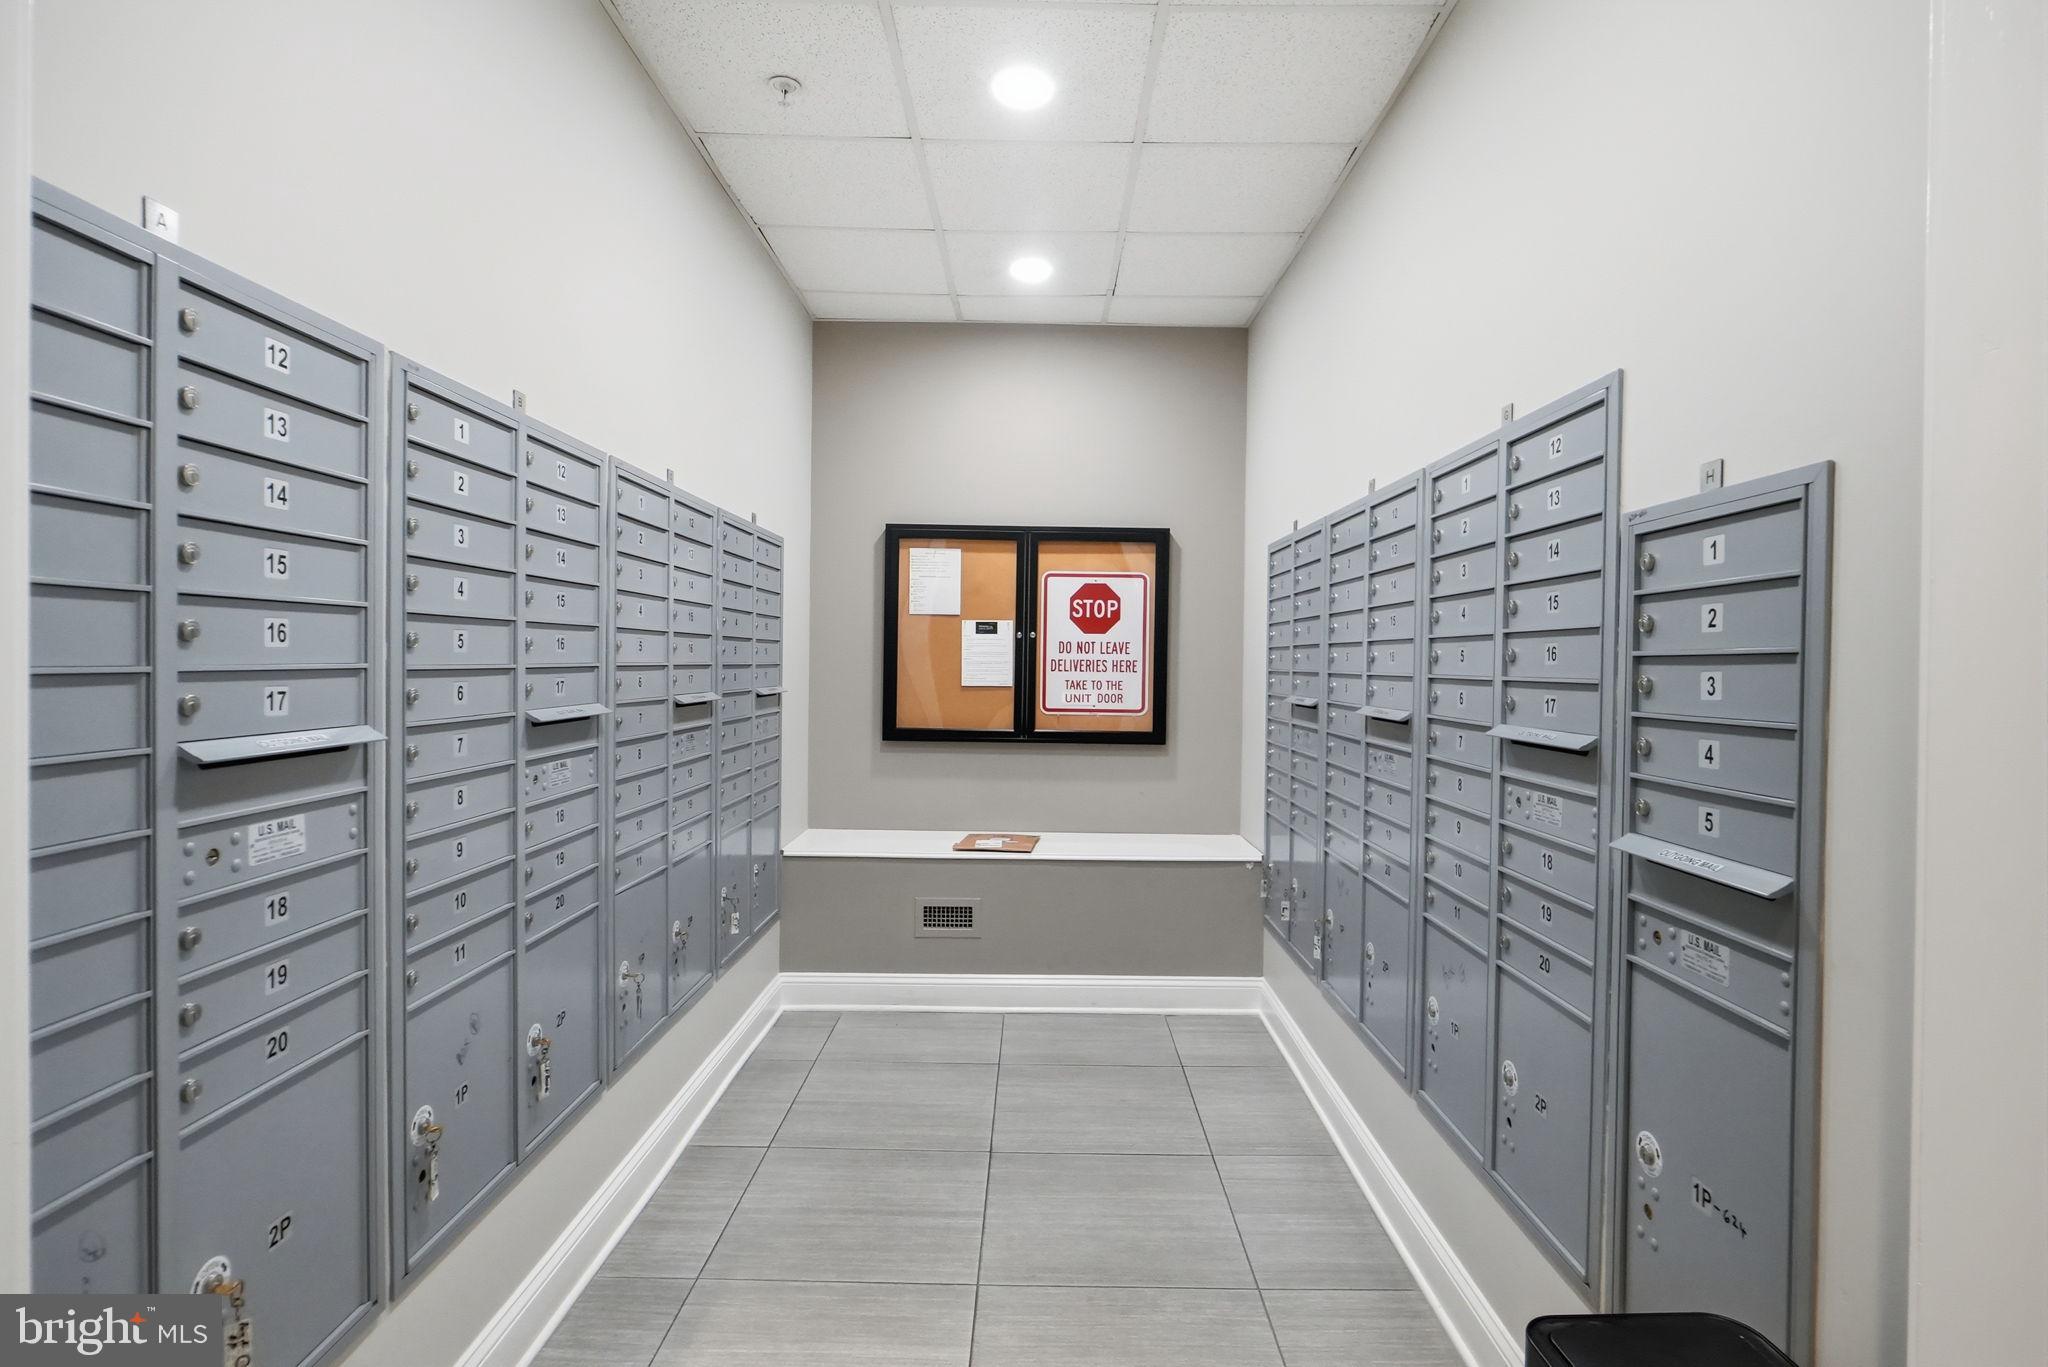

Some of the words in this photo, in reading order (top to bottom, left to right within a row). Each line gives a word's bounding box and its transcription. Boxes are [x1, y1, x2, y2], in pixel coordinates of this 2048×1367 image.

[157, 213, 168, 230] A
[268, 342, 288, 369] 12
[267, 413, 287, 437] 13
[459, 424, 465, 439] 1
[1551, 438, 1561, 455] 12
[557, 464, 566, 478] 12
[1706, 470, 1714, 484] H
[458, 477, 465, 491] 2
[1463, 478, 1469, 490] 1
[267, 483, 287, 506] 14
[1549, 490, 1560, 506] 13
[557, 508, 566, 521] 13
[1462, 521, 1468, 534] 2
[458, 529, 465, 544] 3
[557, 551, 565, 564] 14
[1549, 542, 1559, 559] 14
[1709, 540, 1718, 560] 1
[267, 553, 287, 574] 15
[1461, 565, 1467, 577] 3
[457, 581, 464, 597] 4
[557, 594, 565, 607] 15
[1548, 595, 1559, 611] 15
[1072, 599, 1118, 619] STOP
[1461, 607, 1467, 619] 4
[1708, 608, 1717, 628] 2
[267, 622, 287, 643] 16
[457, 634, 465, 648] 5
[556, 637, 565, 650] 16
[1058, 641, 1072, 654] DO
[1076, 641, 1096, 654] NOT
[1100, 641, 1130, 654] LEAVE
[1459, 650, 1465, 662] 5
[1547, 646, 1557, 661] 16
[1050, 659, 1108, 672] DELIVERIES
[1112, 660, 1138, 673] HERE
[556, 681, 564, 693] 17
[1065, 680, 1087, 690] TAKE
[1091, 680, 1103, 690] TO
[1106, 680, 1123, 690] THE
[1707, 676, 1715, 696] 3
[456, 686, 464, 700] 6
[1065, 693, 1092, 703] UNIT
[1097, 693, 1123, 703] DOOR
[1458, 692, 1465, 705] 6
[266, 691, 287, 711] 17
[1545, 699, 1556, 713] 17
[457, 738, 464, 752] 7
[1458, 735, 1464, 748] 7
[1704, 744, 1714, 764] 4
[1457, 778, 1463, 791] 8
[456, 790, 464, 805] 8
[556, 810, 564, 823] 18
[1704, 812, 1713, 832] 5
[257, 824, 274, 836] U.S.
[277, 819, 297, 831] MAIL
[1455, 821, 1462, 833] 9
[456, 842, 464, 857] 9
[556, 852, 564, 866] 19
[1542, 853, 1552, 870] 18
[1659, 849, 1700, 866] OUTGOING
[1698, 861, 1720, 872] MAIL
[1454, 863, 1463, 877] 10
[267, 896, 287, 920] 18
[455, 893, 466, 910] 10
[556, 895, 564, 910] 20
[1453, 906, 1461, 919] 11
[1541, 904, 1551, 922] 19
[455, 944, 465, 961] 11
[1688, 934, 1701, 948] U.S.
[1703, 940, 1721, 957] MAIL
[1539, 955, 1550, 973] 20
[267, 964, 287, 989] 19
[1451, 1022, 1459, 1036] 1P
[267, 1032, 288, 1059] 20
[456, 1085, 468, 1104] 1P
[1535, 1094, 1547, 1113] 2P
[1693, 1183, 1747, 1238] 1P-624
[269, 1215, 291, 1248] 2P
